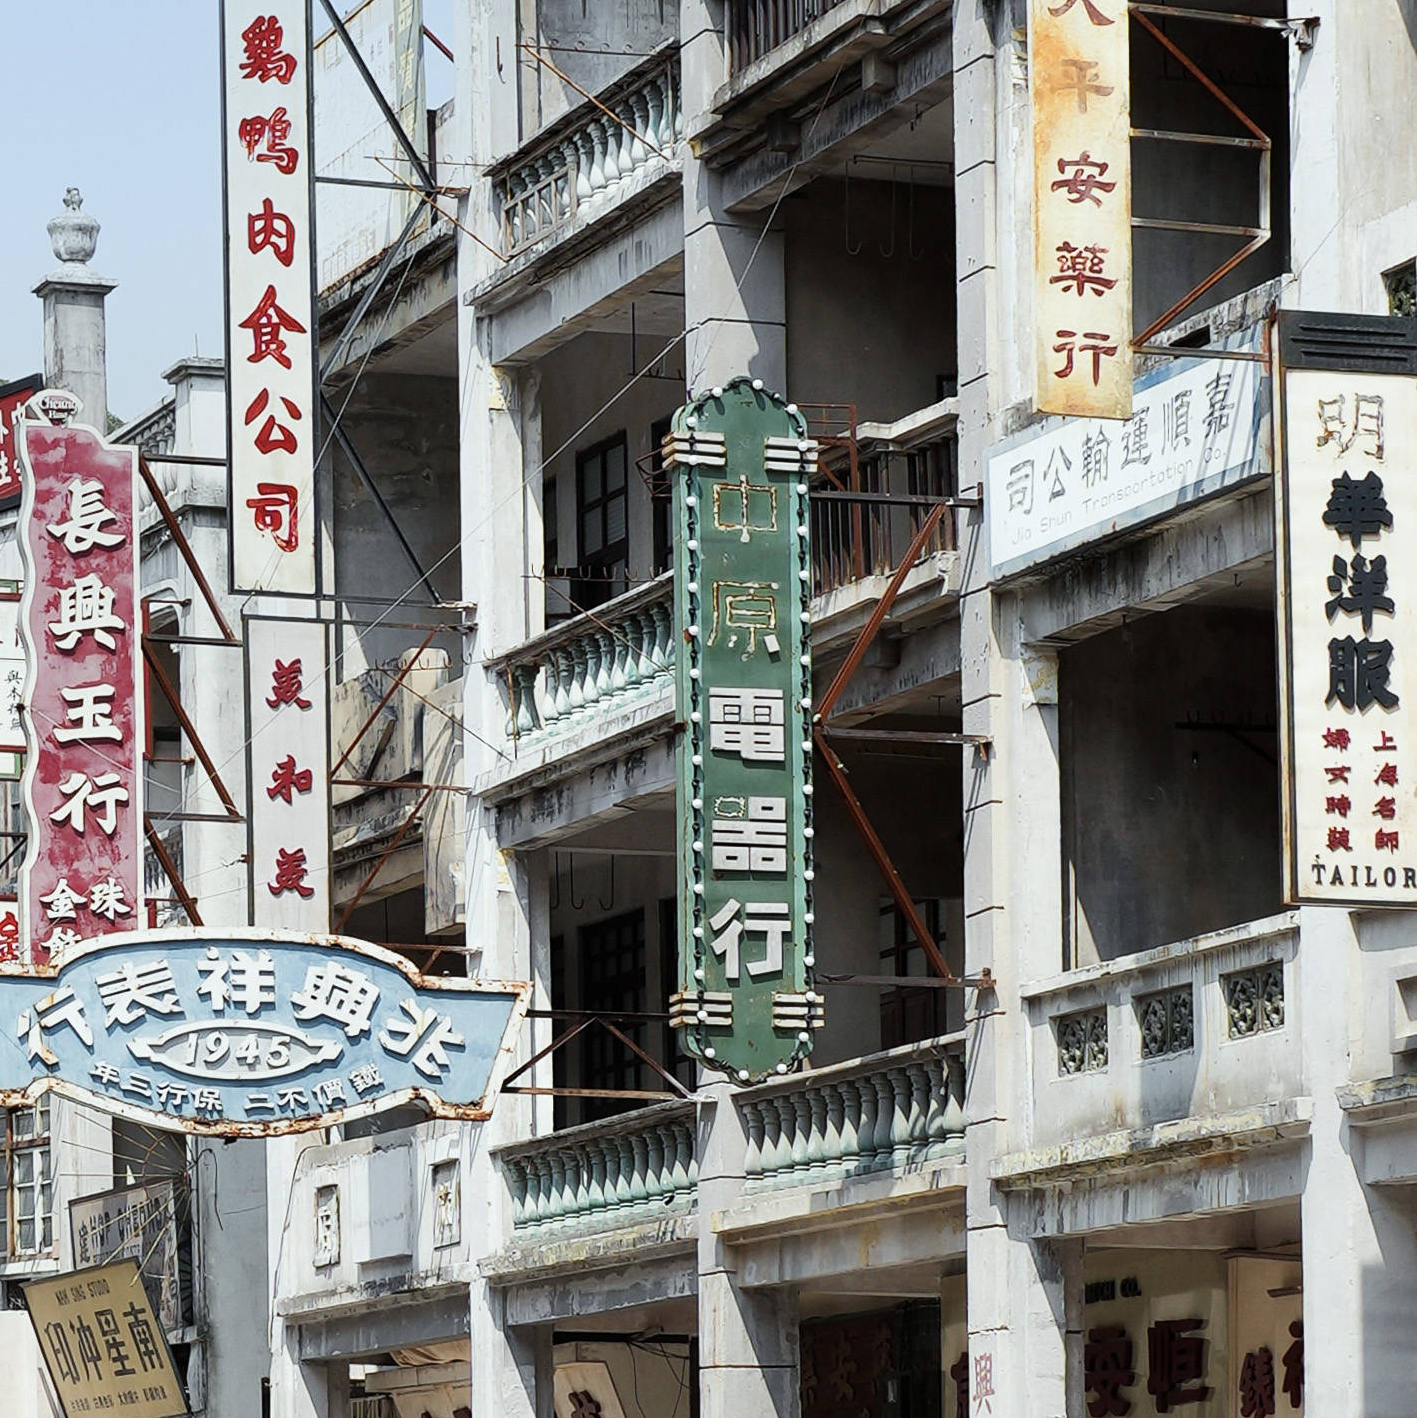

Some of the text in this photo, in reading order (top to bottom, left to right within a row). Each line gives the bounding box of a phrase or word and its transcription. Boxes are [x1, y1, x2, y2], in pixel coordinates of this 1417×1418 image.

[1317, 392, 1401, 712] 明華洋服
[47, 477, 129, 835] 長興玉行
[1311, 863, 1417, 889] TAILOR
[183, 1031, 293, 1068] 1945
